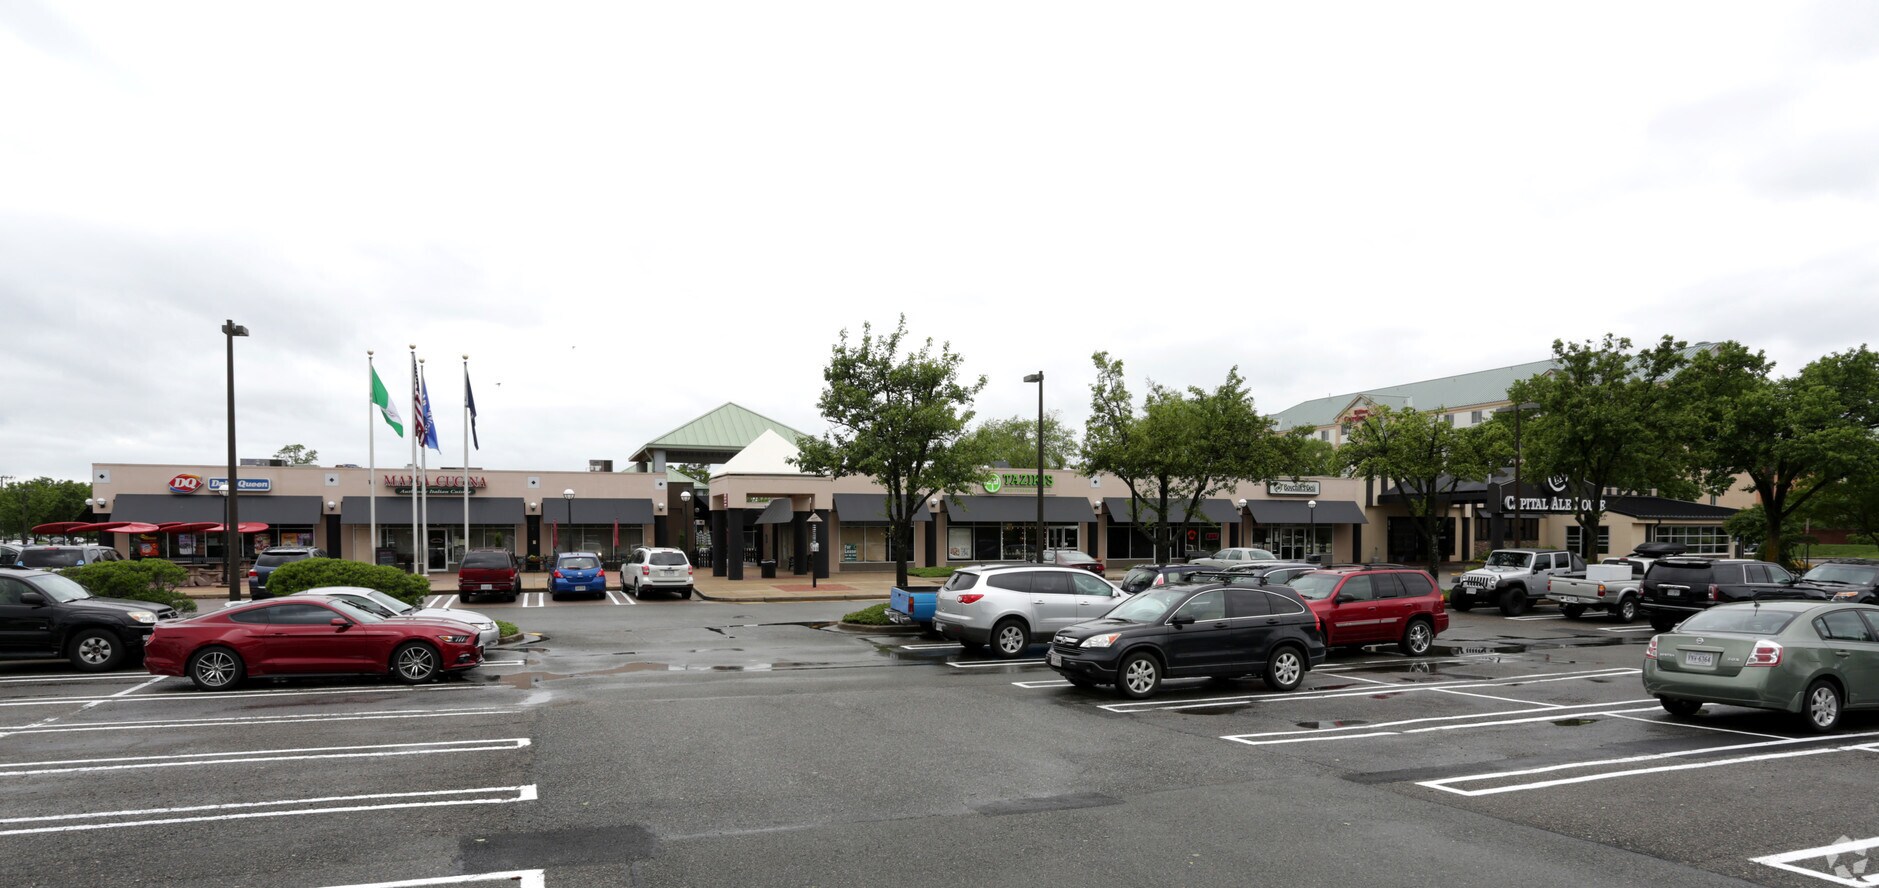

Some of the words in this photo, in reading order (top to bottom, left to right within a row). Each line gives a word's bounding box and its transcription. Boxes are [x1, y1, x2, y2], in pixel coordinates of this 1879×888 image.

[174, 478, 197, 489] DQ
[238, 480, 268, 488] Queen
[436, 475, 487, 488] CUCNA
[1505, 496, 1549, 510] CPITAL
[1551, 497, 1572, 511] ALE
[1574, 497, 1606, 512] OUE
